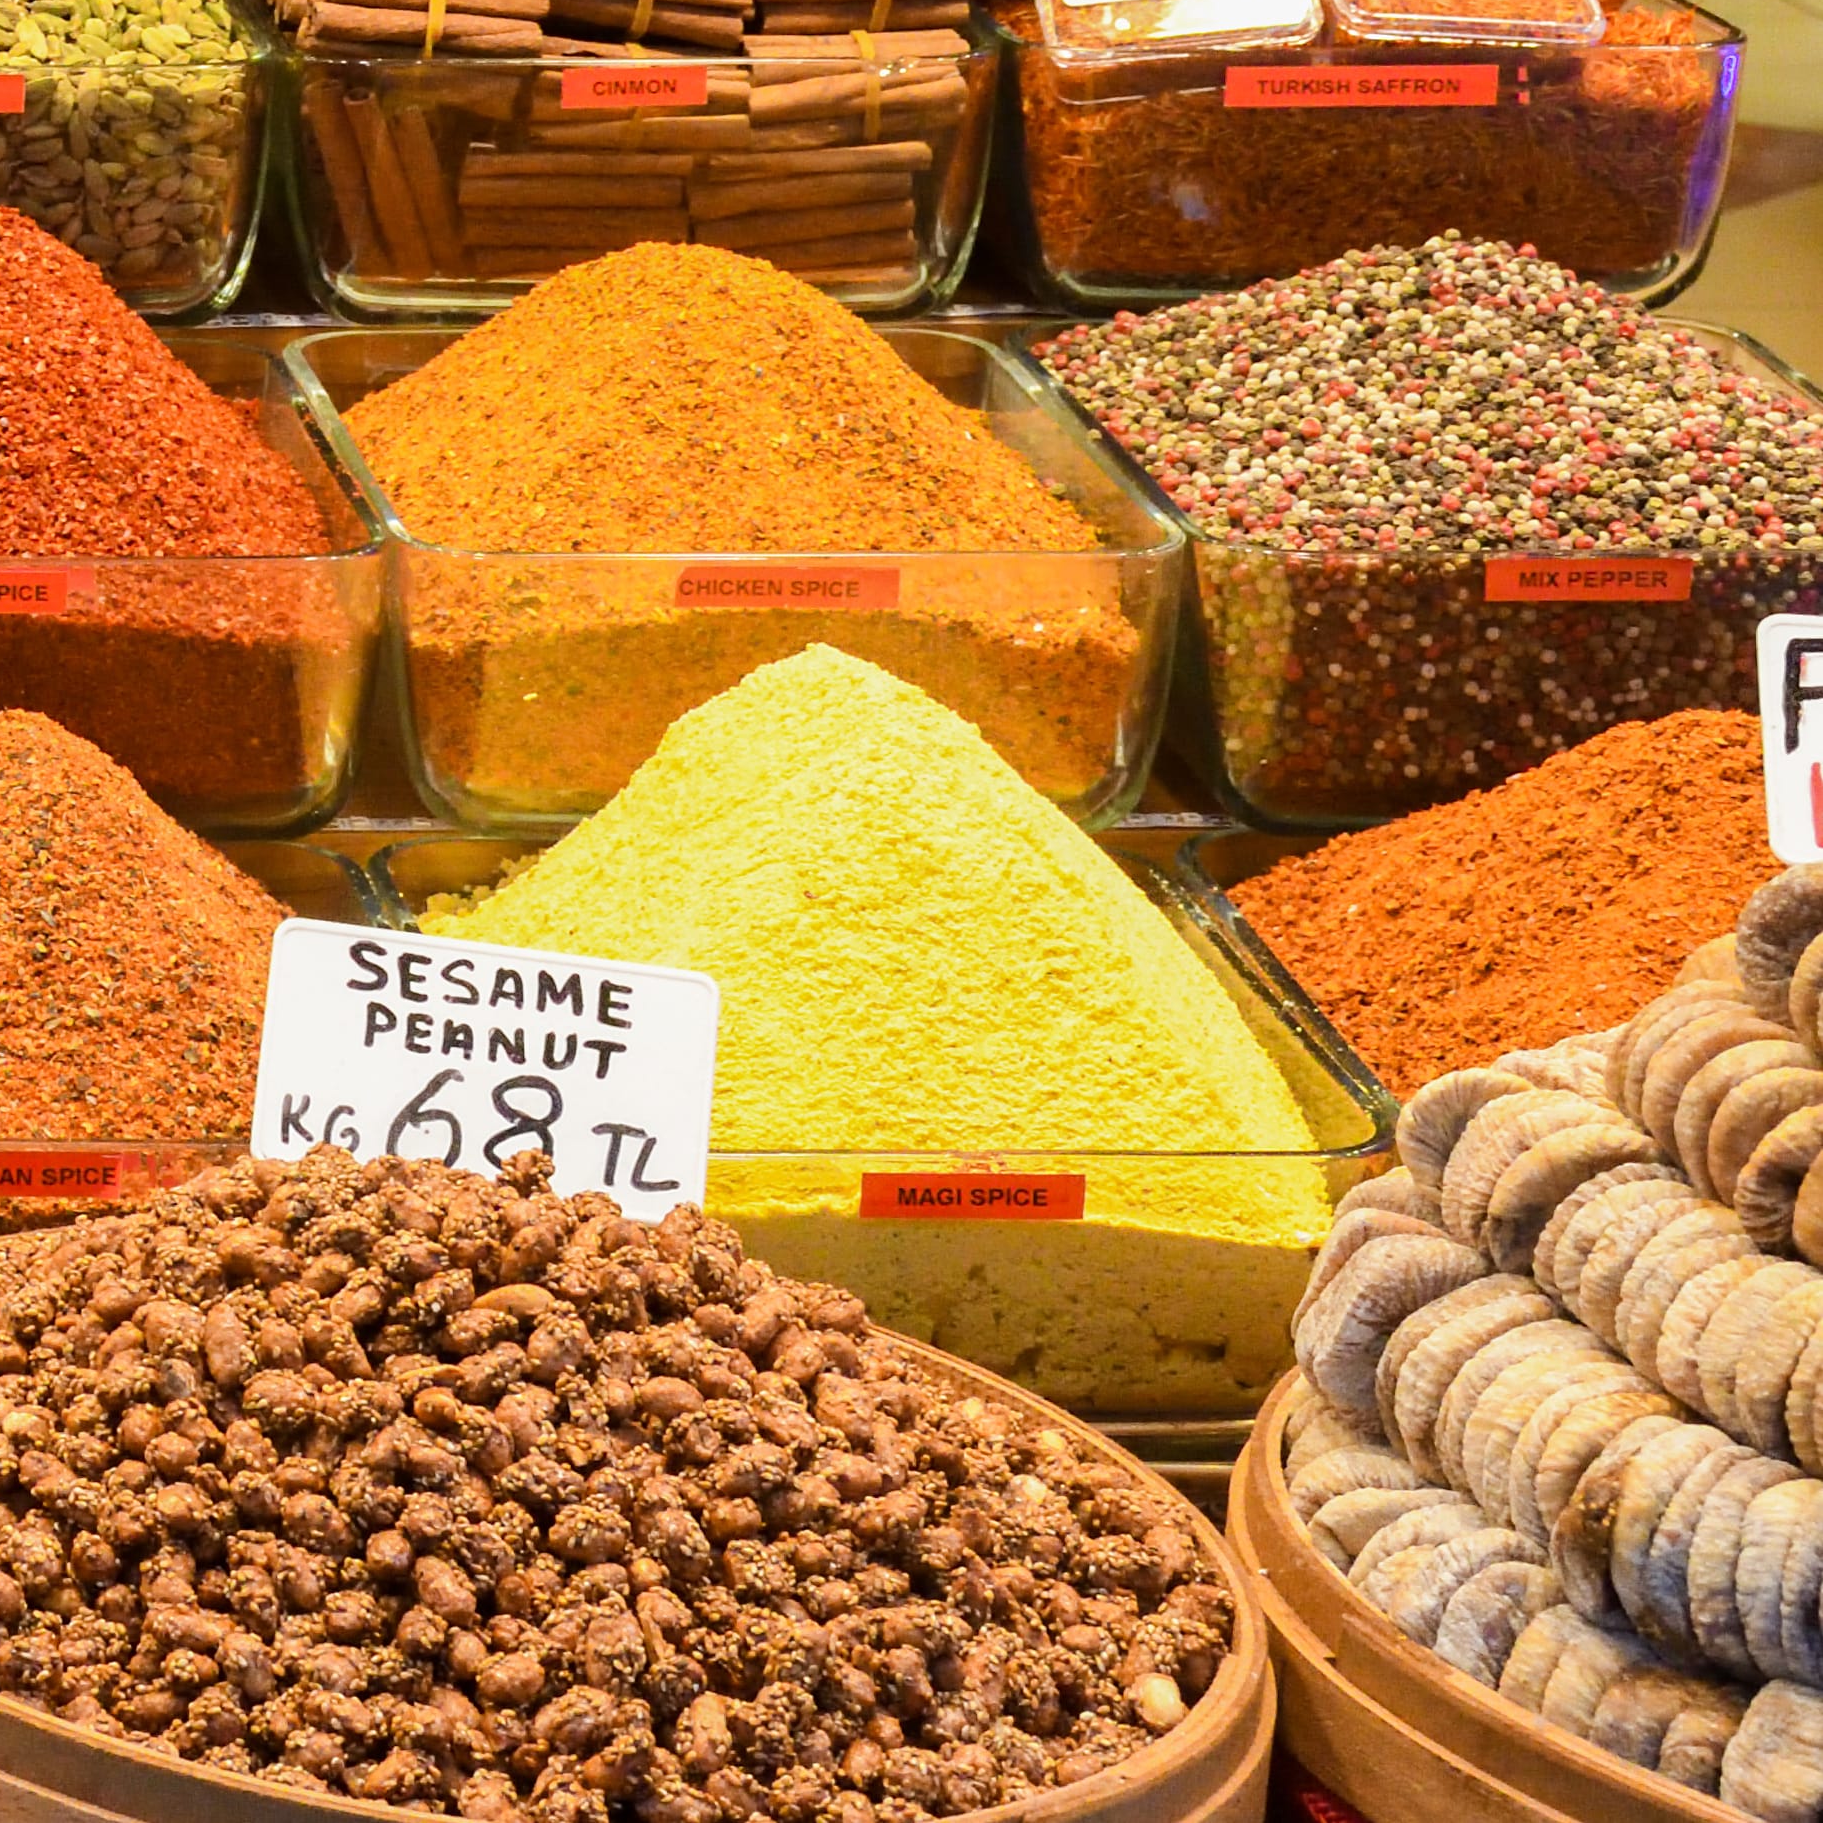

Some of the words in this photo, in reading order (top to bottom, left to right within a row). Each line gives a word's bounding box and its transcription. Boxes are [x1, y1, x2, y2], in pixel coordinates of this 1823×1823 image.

[592, 79, 677, 96] CINMON
[1257, 79, 1351, 95] TURKISH
[1358, 78, 1462, 94] SAFFRON
[678, 579, 783, 596] CHICKEN
[790, 580, 860, 597] SPICE
[1519, 571, 1560, 588] MIX
[1567, 570, 1668, 588] PEPPER
[346, 940, 634, 1030] SESAME
[363, 1001, 627, 1079] PEANUT
[280, 1092, 360, 1154] KG
[385, 1068, 564, 1172] 68
[591, 1122, 681, 1192] TL
[41, 1166, 117, 1186] SPICE
[897, 1187, 962, 1206] MAGI
[970, 1188, 1049, 1207] SPICE
